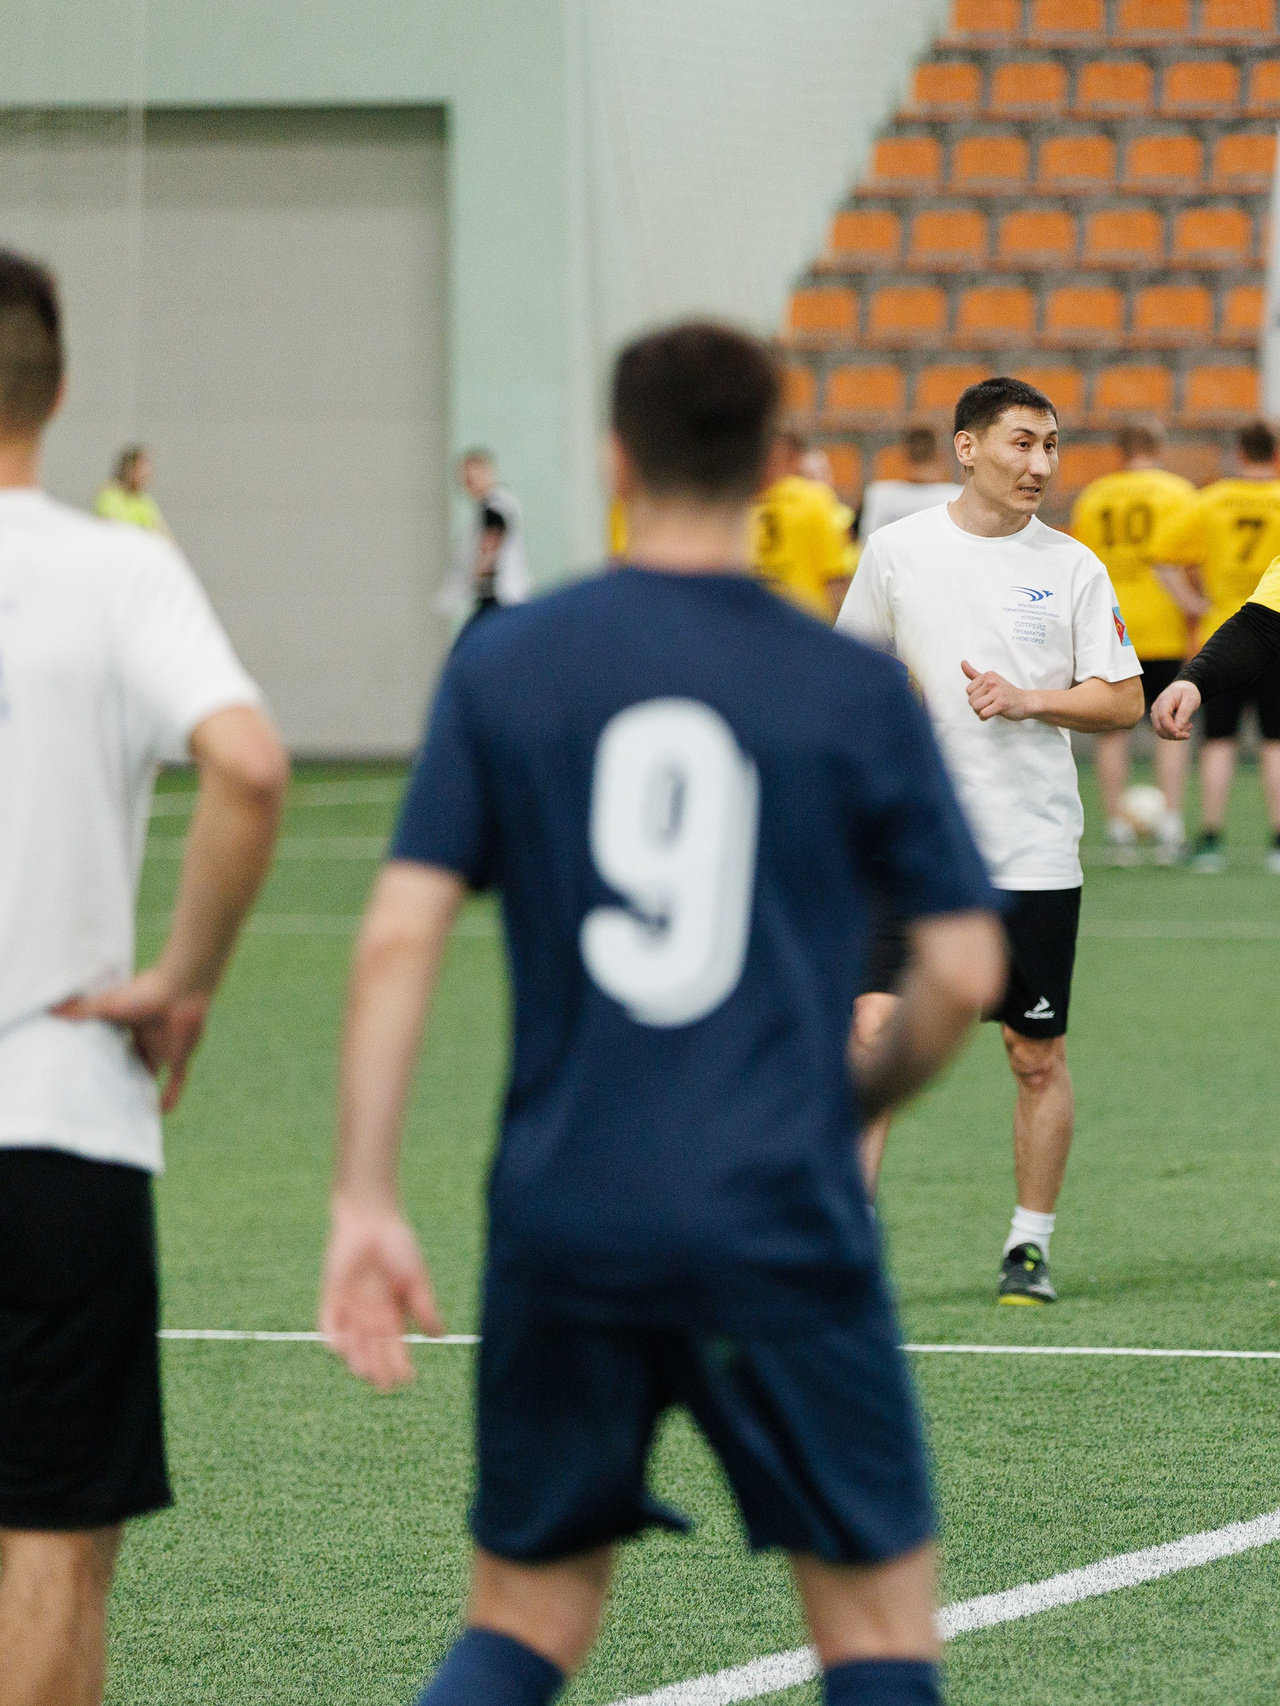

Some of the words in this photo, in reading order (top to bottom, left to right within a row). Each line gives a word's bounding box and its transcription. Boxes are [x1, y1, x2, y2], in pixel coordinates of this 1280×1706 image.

[1100, 502, 1153, 547] 10
[1235, 516, 1265, 562] 7
[1013, 629, 1046, 637] ПРОМАКТИВ
[1015, 621, 1046, 631] ОЛТРЕЙД
[579, 695, 761, 1030] 9
